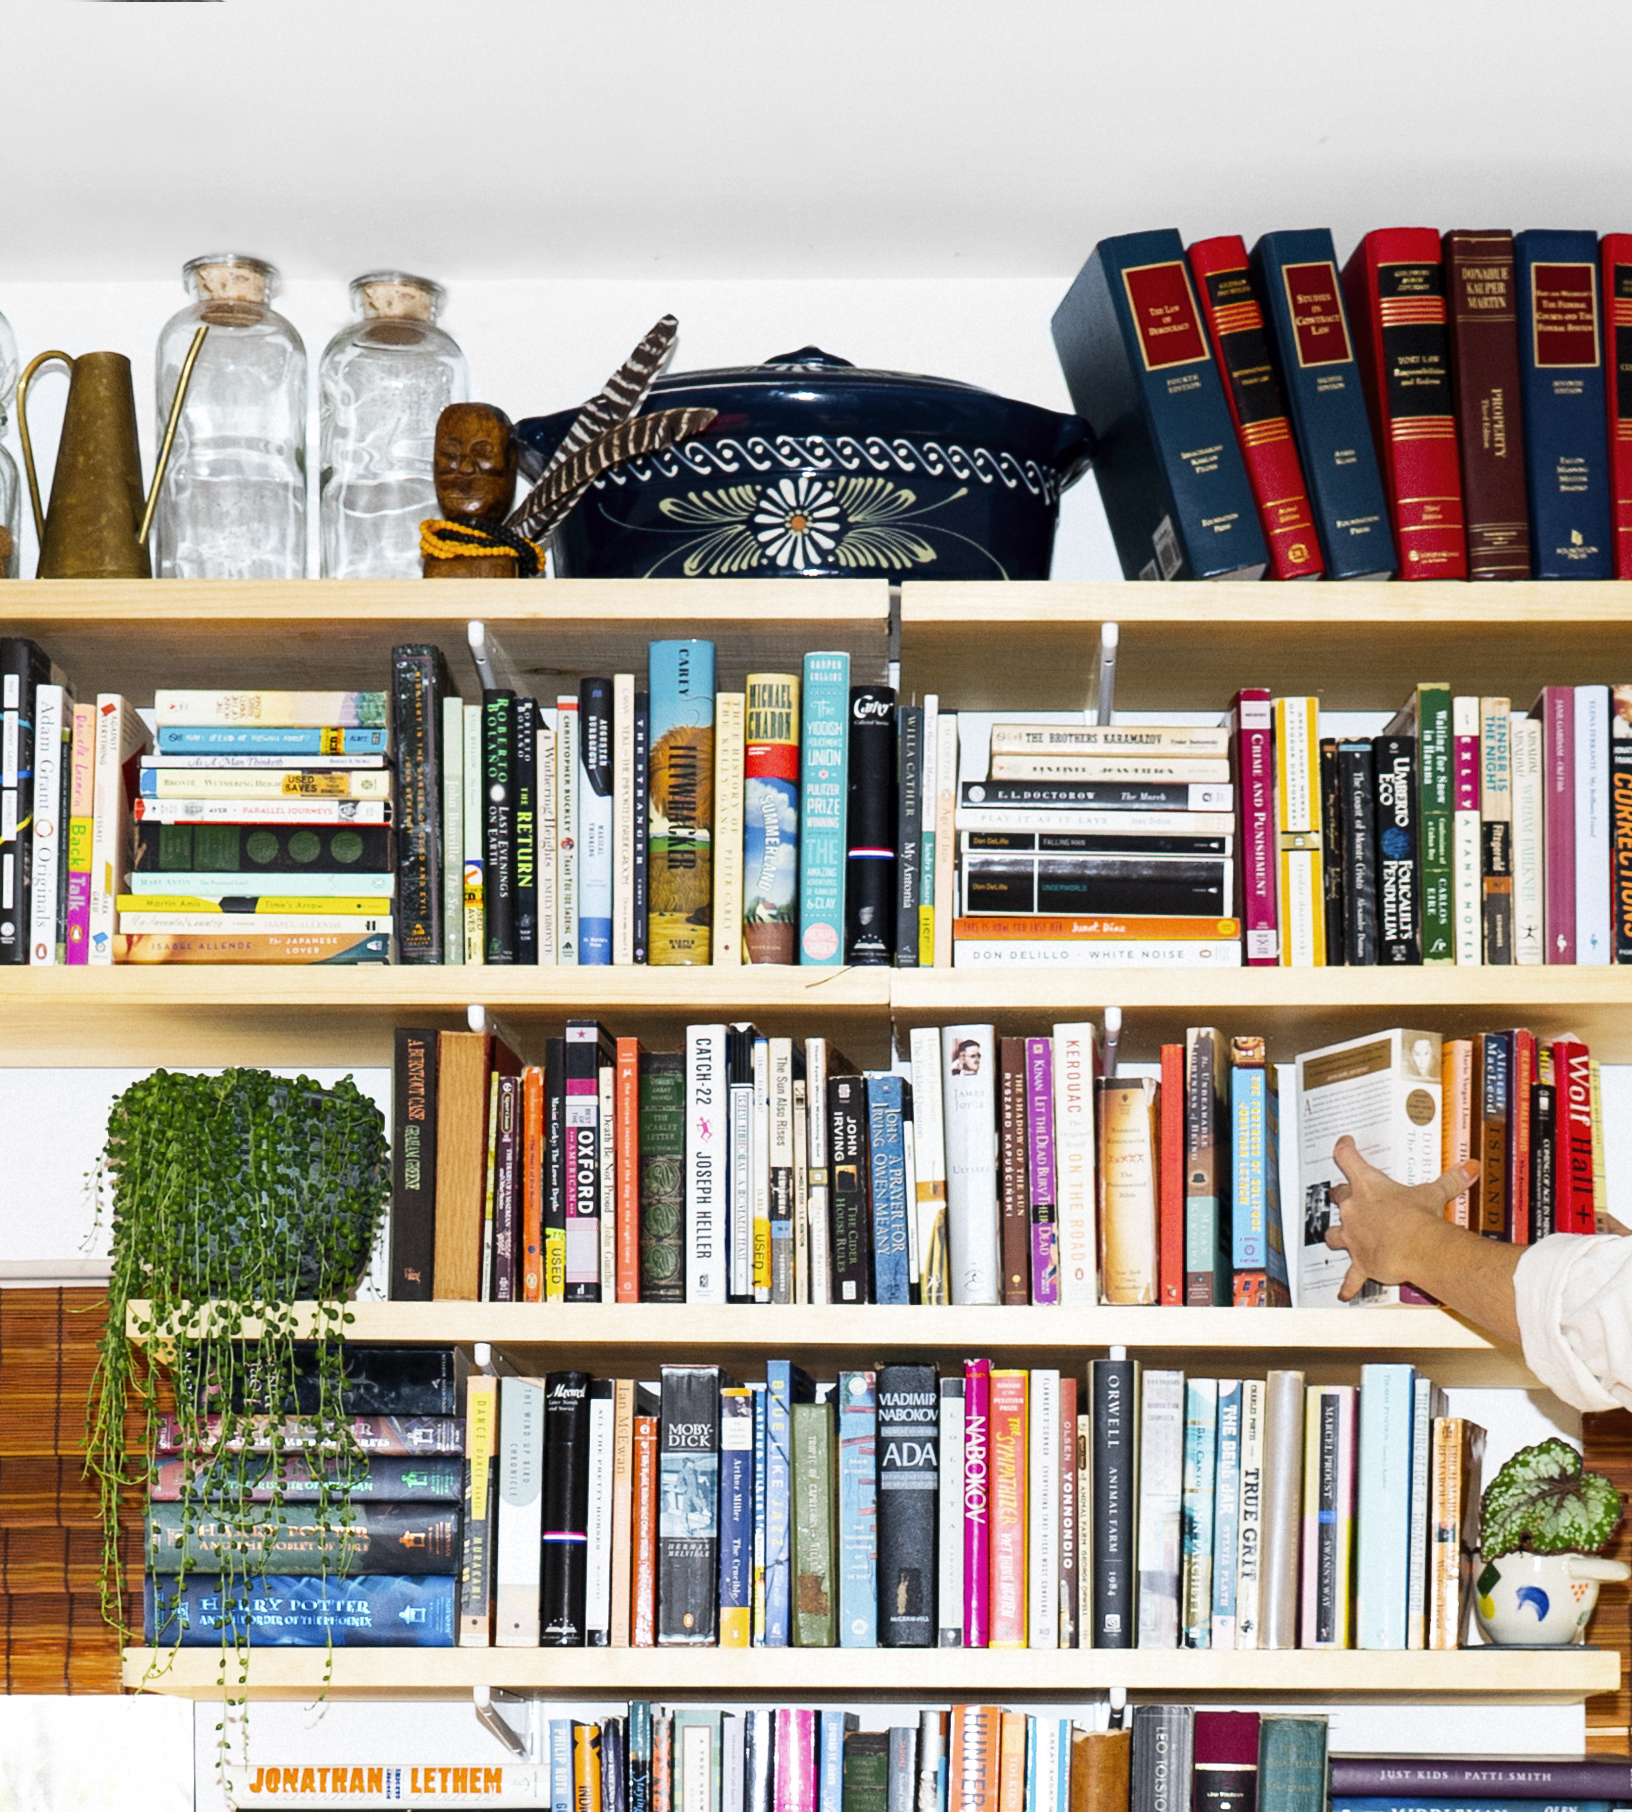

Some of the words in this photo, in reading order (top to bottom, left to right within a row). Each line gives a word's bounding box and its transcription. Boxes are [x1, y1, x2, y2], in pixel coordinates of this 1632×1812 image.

[1489, 389, 1506, 457] PROPERTY
[1251, 734, 1263, 773] CRIME
[1253, 782, 1264, 807] AND
[1395, 757, 1409, 827] UMBERTO
[1254, 812, 1266, 895] PUNISHMENT
[696, 1038, 712, 1104] CATCH-22
[1569, 1056, 1590, 1125] Wolf
[578, 1131, 594, 1214] OXFORD
[696, 1152, 712, 1204] JOSEPH
[1574, 1136, 1593, 1194] Hall
[696, 1211, 711, 1258] HELLER
[879, 1394, 937, 1406] VLADIMIR
[879, 1409, 938, 1421] NABOKOV
[1108, 1375, 1119, 1448] ORWELL
[668, 1424, 713, 1435] MOBY-
[668, 1435, 711, 1447] DICK
[883, 1442, 938, 1466] ADA
[964, 1415, 987, 1525] NABOKOV
[1109, 1467, 1118, 1514] ANIMAL
[1244, 1469, 1258, 1521] TRUE
[1109, 1520, 1117, 1552] FARM
[1242, 1528, 1258, 1580] GRIT
[249, 1767, 384, 1794] JONATHAN
[411, 1768, 503, 1794] LETHEM
[956, 1714, 986, 1808] HUNTER
